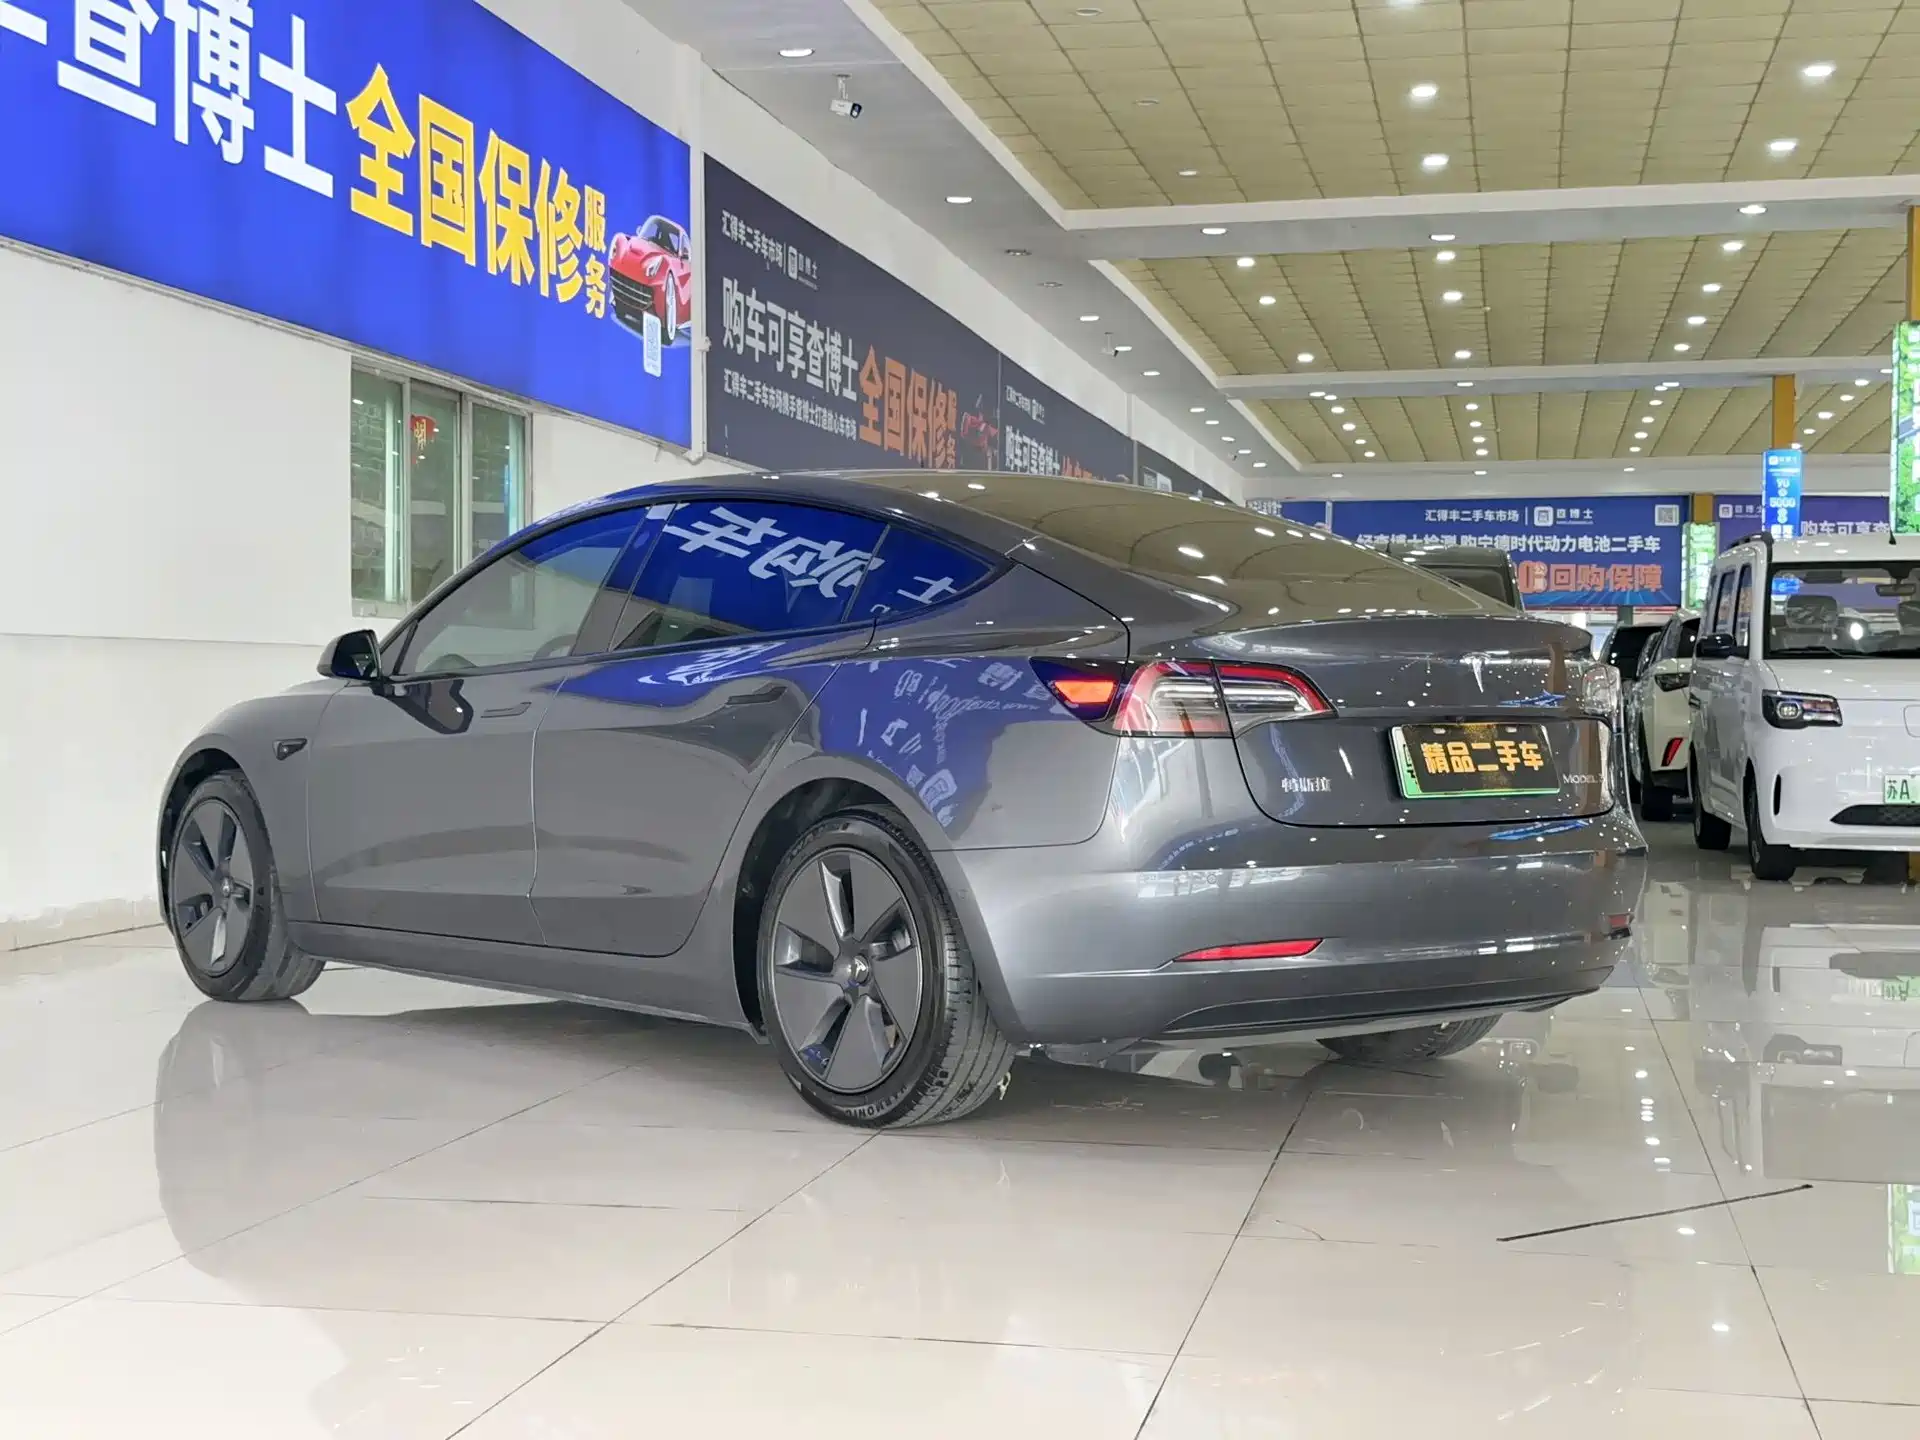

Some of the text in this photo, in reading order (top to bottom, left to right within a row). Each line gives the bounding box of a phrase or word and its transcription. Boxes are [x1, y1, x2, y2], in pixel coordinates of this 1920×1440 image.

[345, 62, 584, 303] 全国保修
[584, 184, 607, 319] 服务
[722, 276, 858, 402] 购车可享查博士
[1425, 509, 1520, 523] 汇得丰二手车市场
[1550, 563, 1664, 592] 回购保障
[1420, 740, 1544, 774] 精品二手车
[1562, 773, 1598, 784] MODEL
